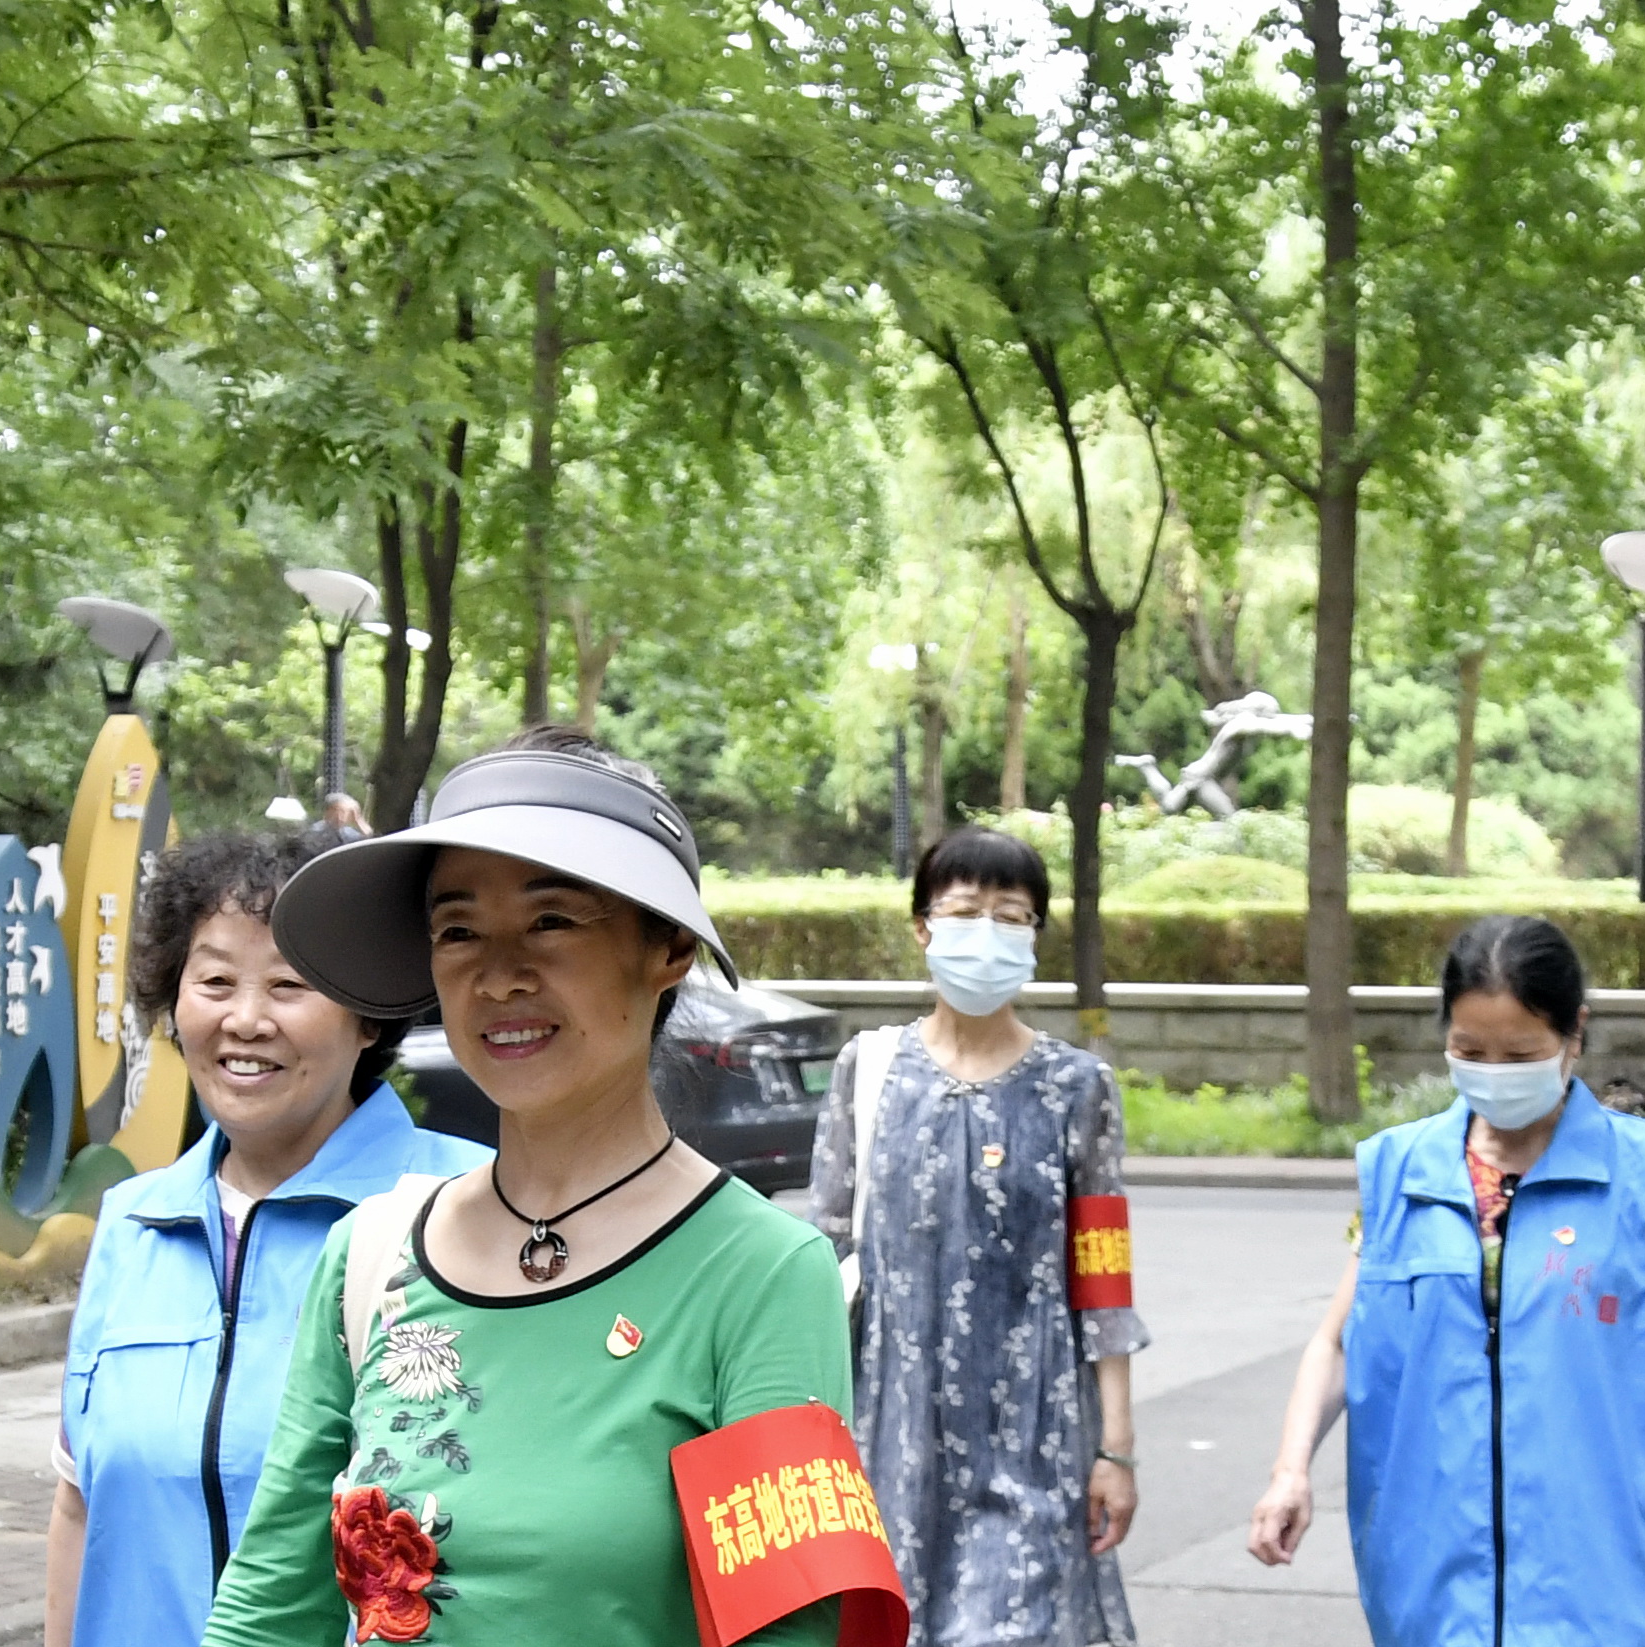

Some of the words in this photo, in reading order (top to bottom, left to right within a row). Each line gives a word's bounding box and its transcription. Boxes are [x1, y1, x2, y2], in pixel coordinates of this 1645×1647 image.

[5, 877, 29, 1036] 人才高地
[96, 893, 118, 1043] 平安高地
